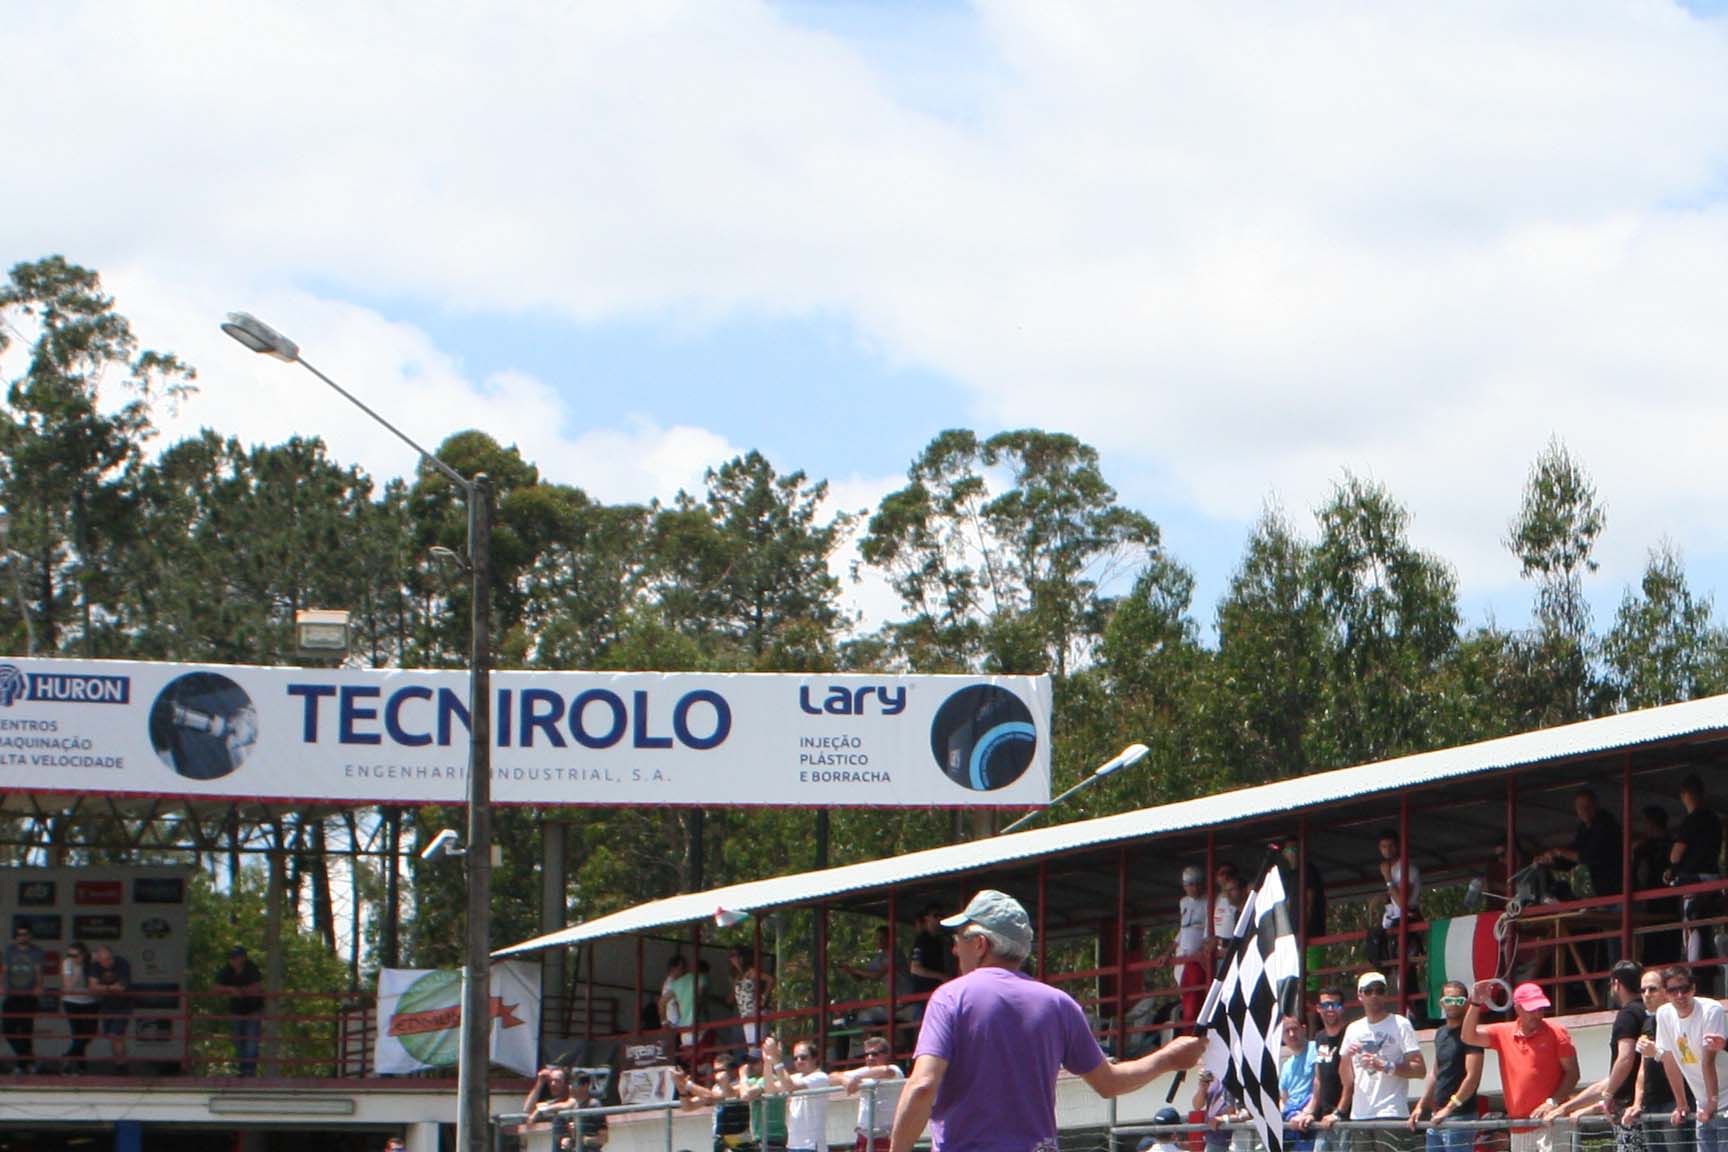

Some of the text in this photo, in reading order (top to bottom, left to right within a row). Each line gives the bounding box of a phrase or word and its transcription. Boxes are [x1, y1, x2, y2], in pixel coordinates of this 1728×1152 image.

[37, 676, 122, 701] HURON
[287, 683, 732, 750] TECNIROLO
[0, 735, 93, 752] AQUINAÇÃO
[800, 734, 861, 751] INJEÇÃO
[31, 755, 125, 768] VELOCIDADE
[800, 751, 869, 765] PLÁSTICO
[632, 768, 672, 783] S.A.
[800, 771, 891, 783] E BORRACHA
